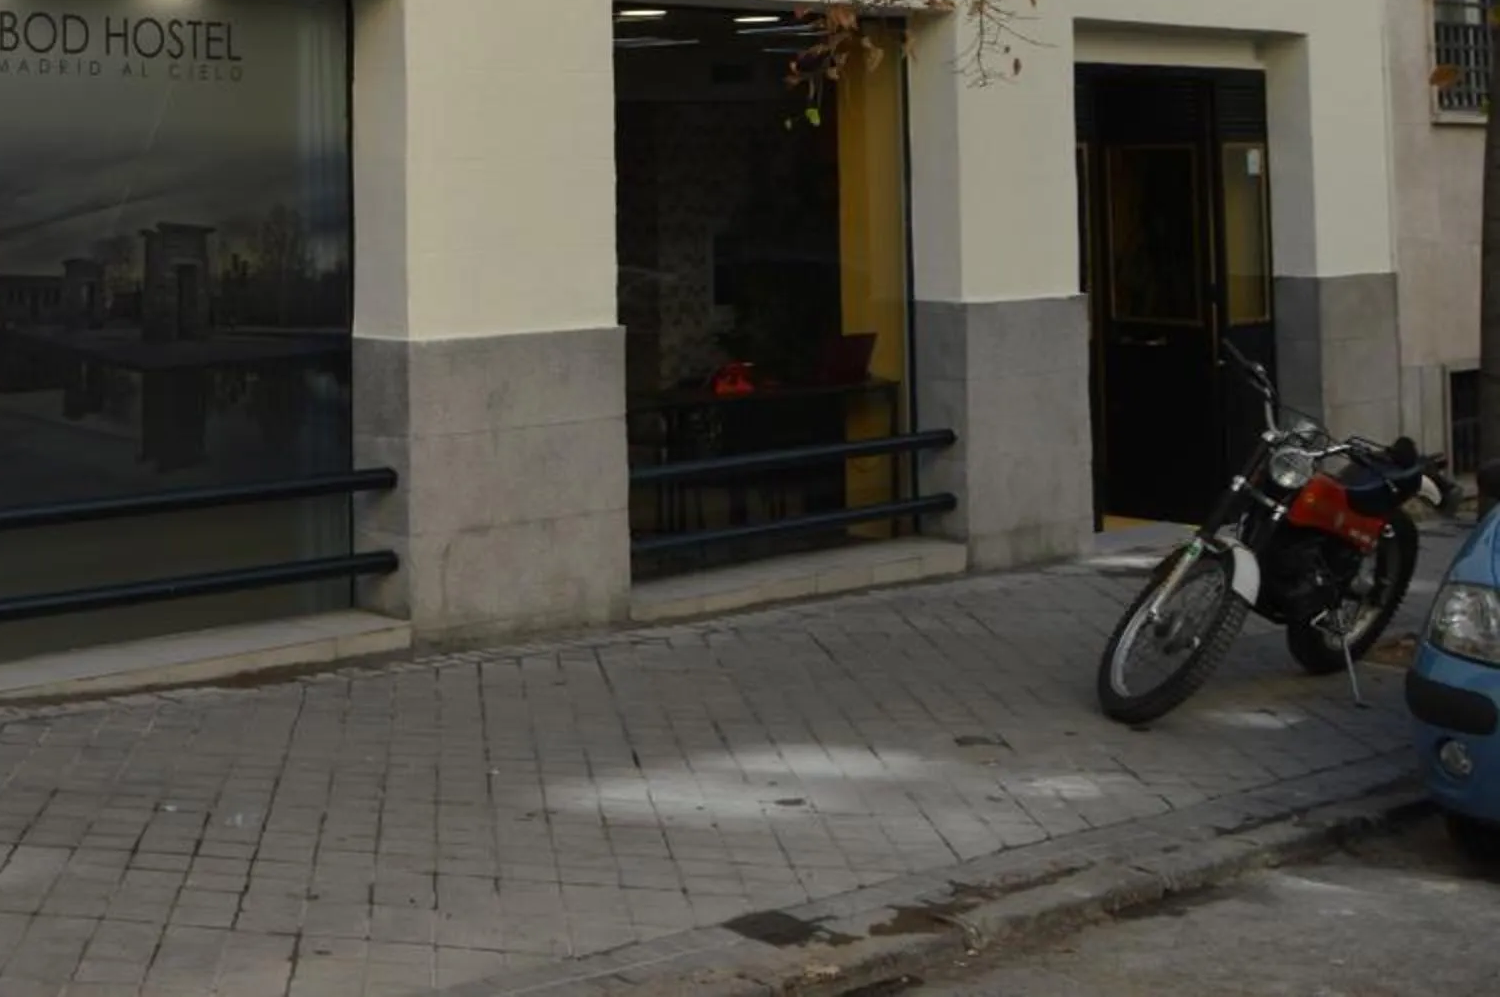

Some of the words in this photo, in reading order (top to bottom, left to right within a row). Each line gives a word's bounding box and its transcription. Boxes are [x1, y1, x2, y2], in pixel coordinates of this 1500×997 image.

[105, 16, 242, 62] HOSTEL
[122, 61, 149, 80] AL
[168, 63, 244, 83] CIELO
